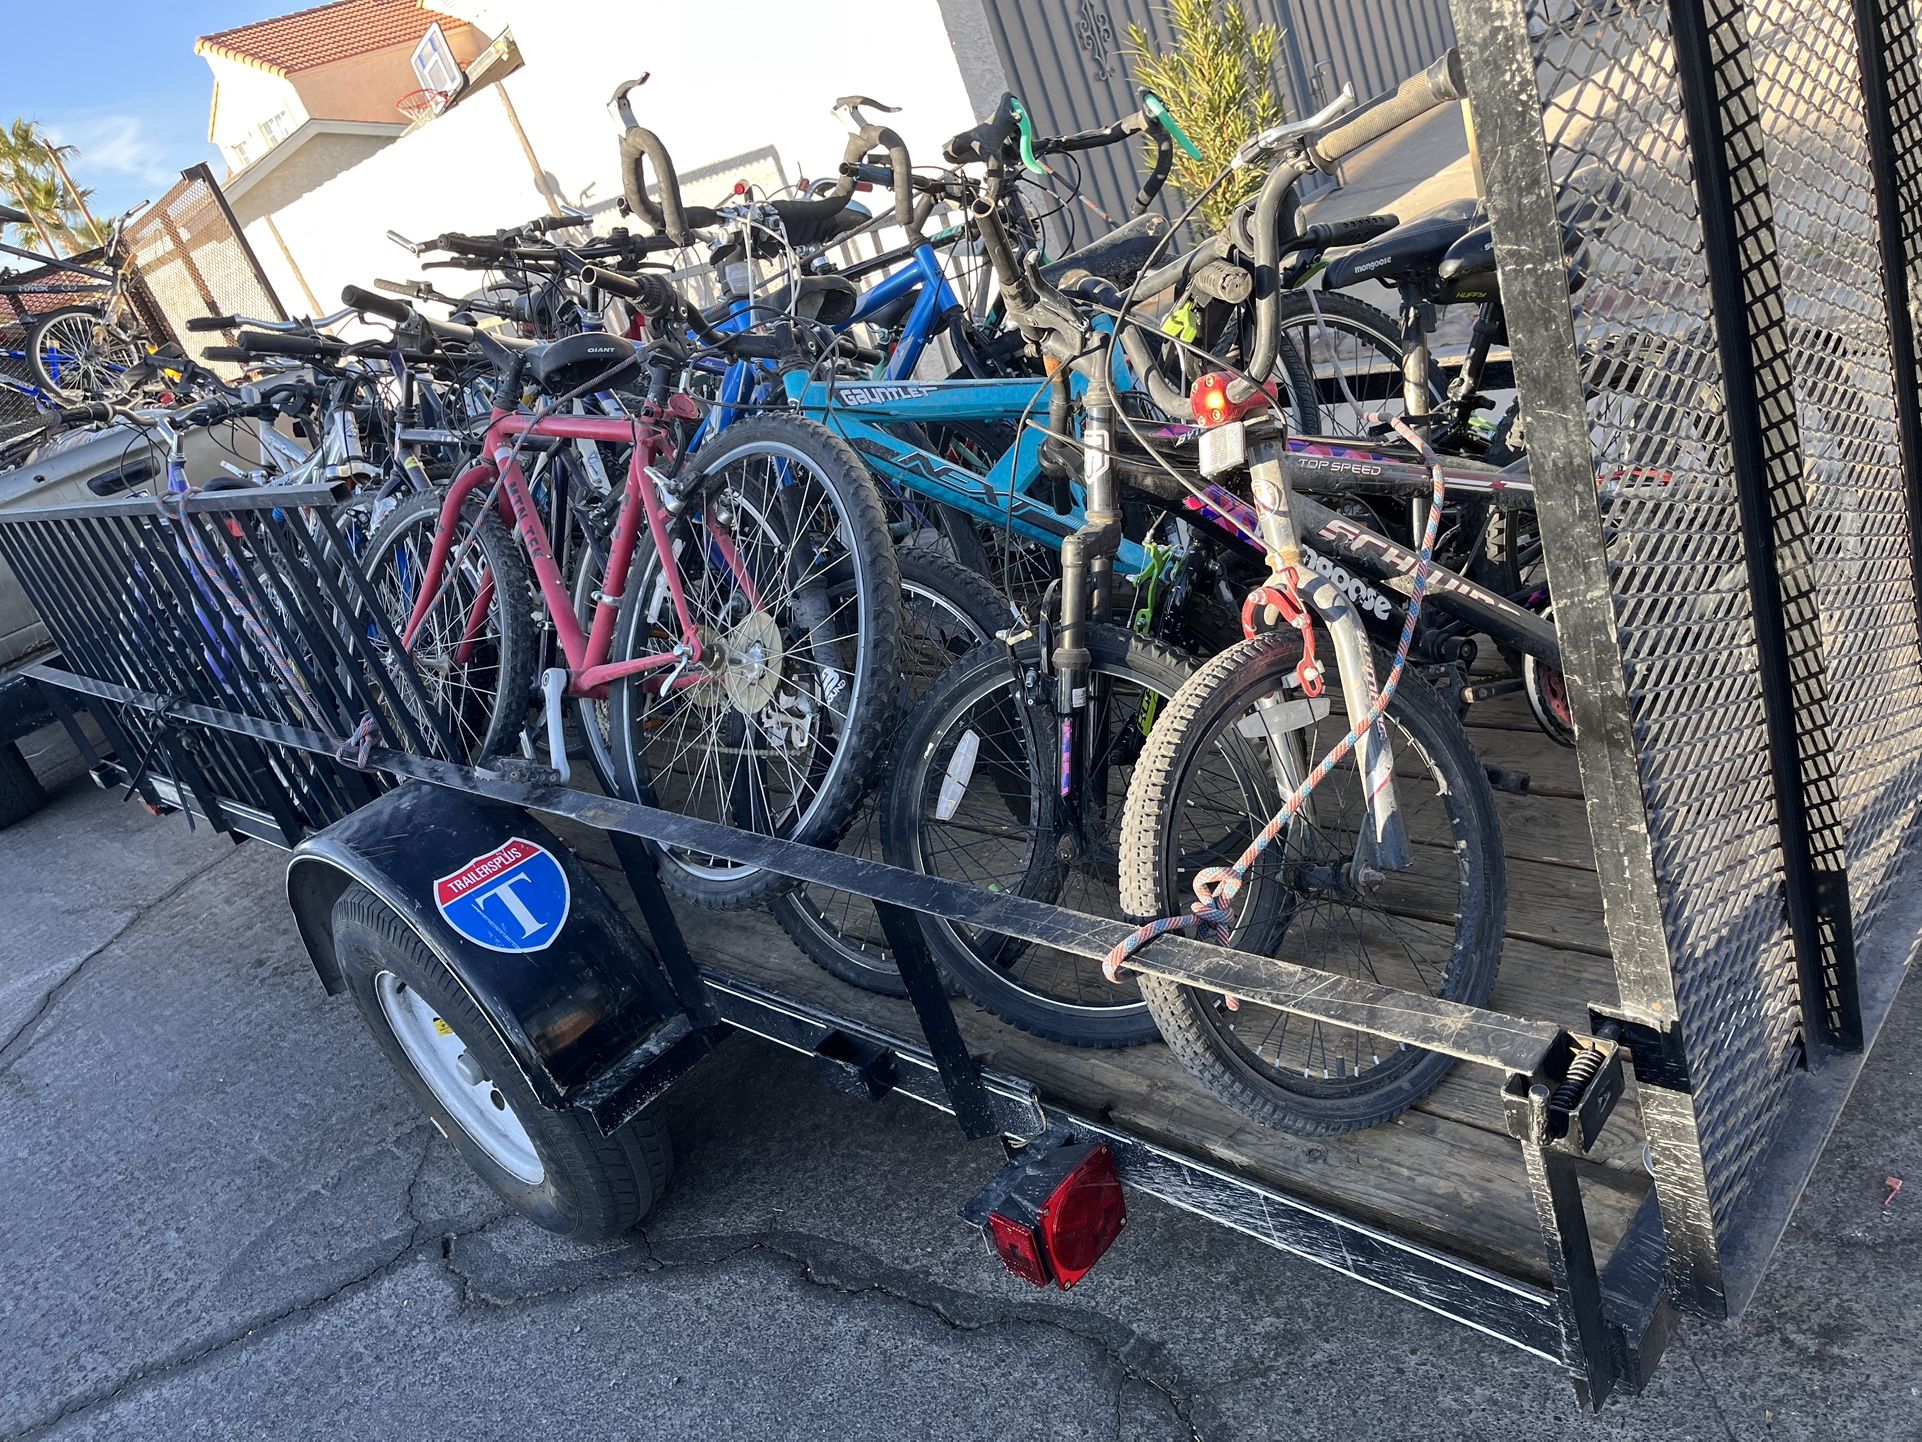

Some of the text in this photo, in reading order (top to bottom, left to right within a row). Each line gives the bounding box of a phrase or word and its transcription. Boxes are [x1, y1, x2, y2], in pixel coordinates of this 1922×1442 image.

[1354, 256, 1392, 274] mongoose
[1456, 291, 1487, 299] HUFFY
[1298, 458, 1382, 476] TOP SPEED
[507, 481, 528, 522] MTN
[447, 847, 522, 894] TRAILERSPLUS
[474, 871, 548, 940] T
